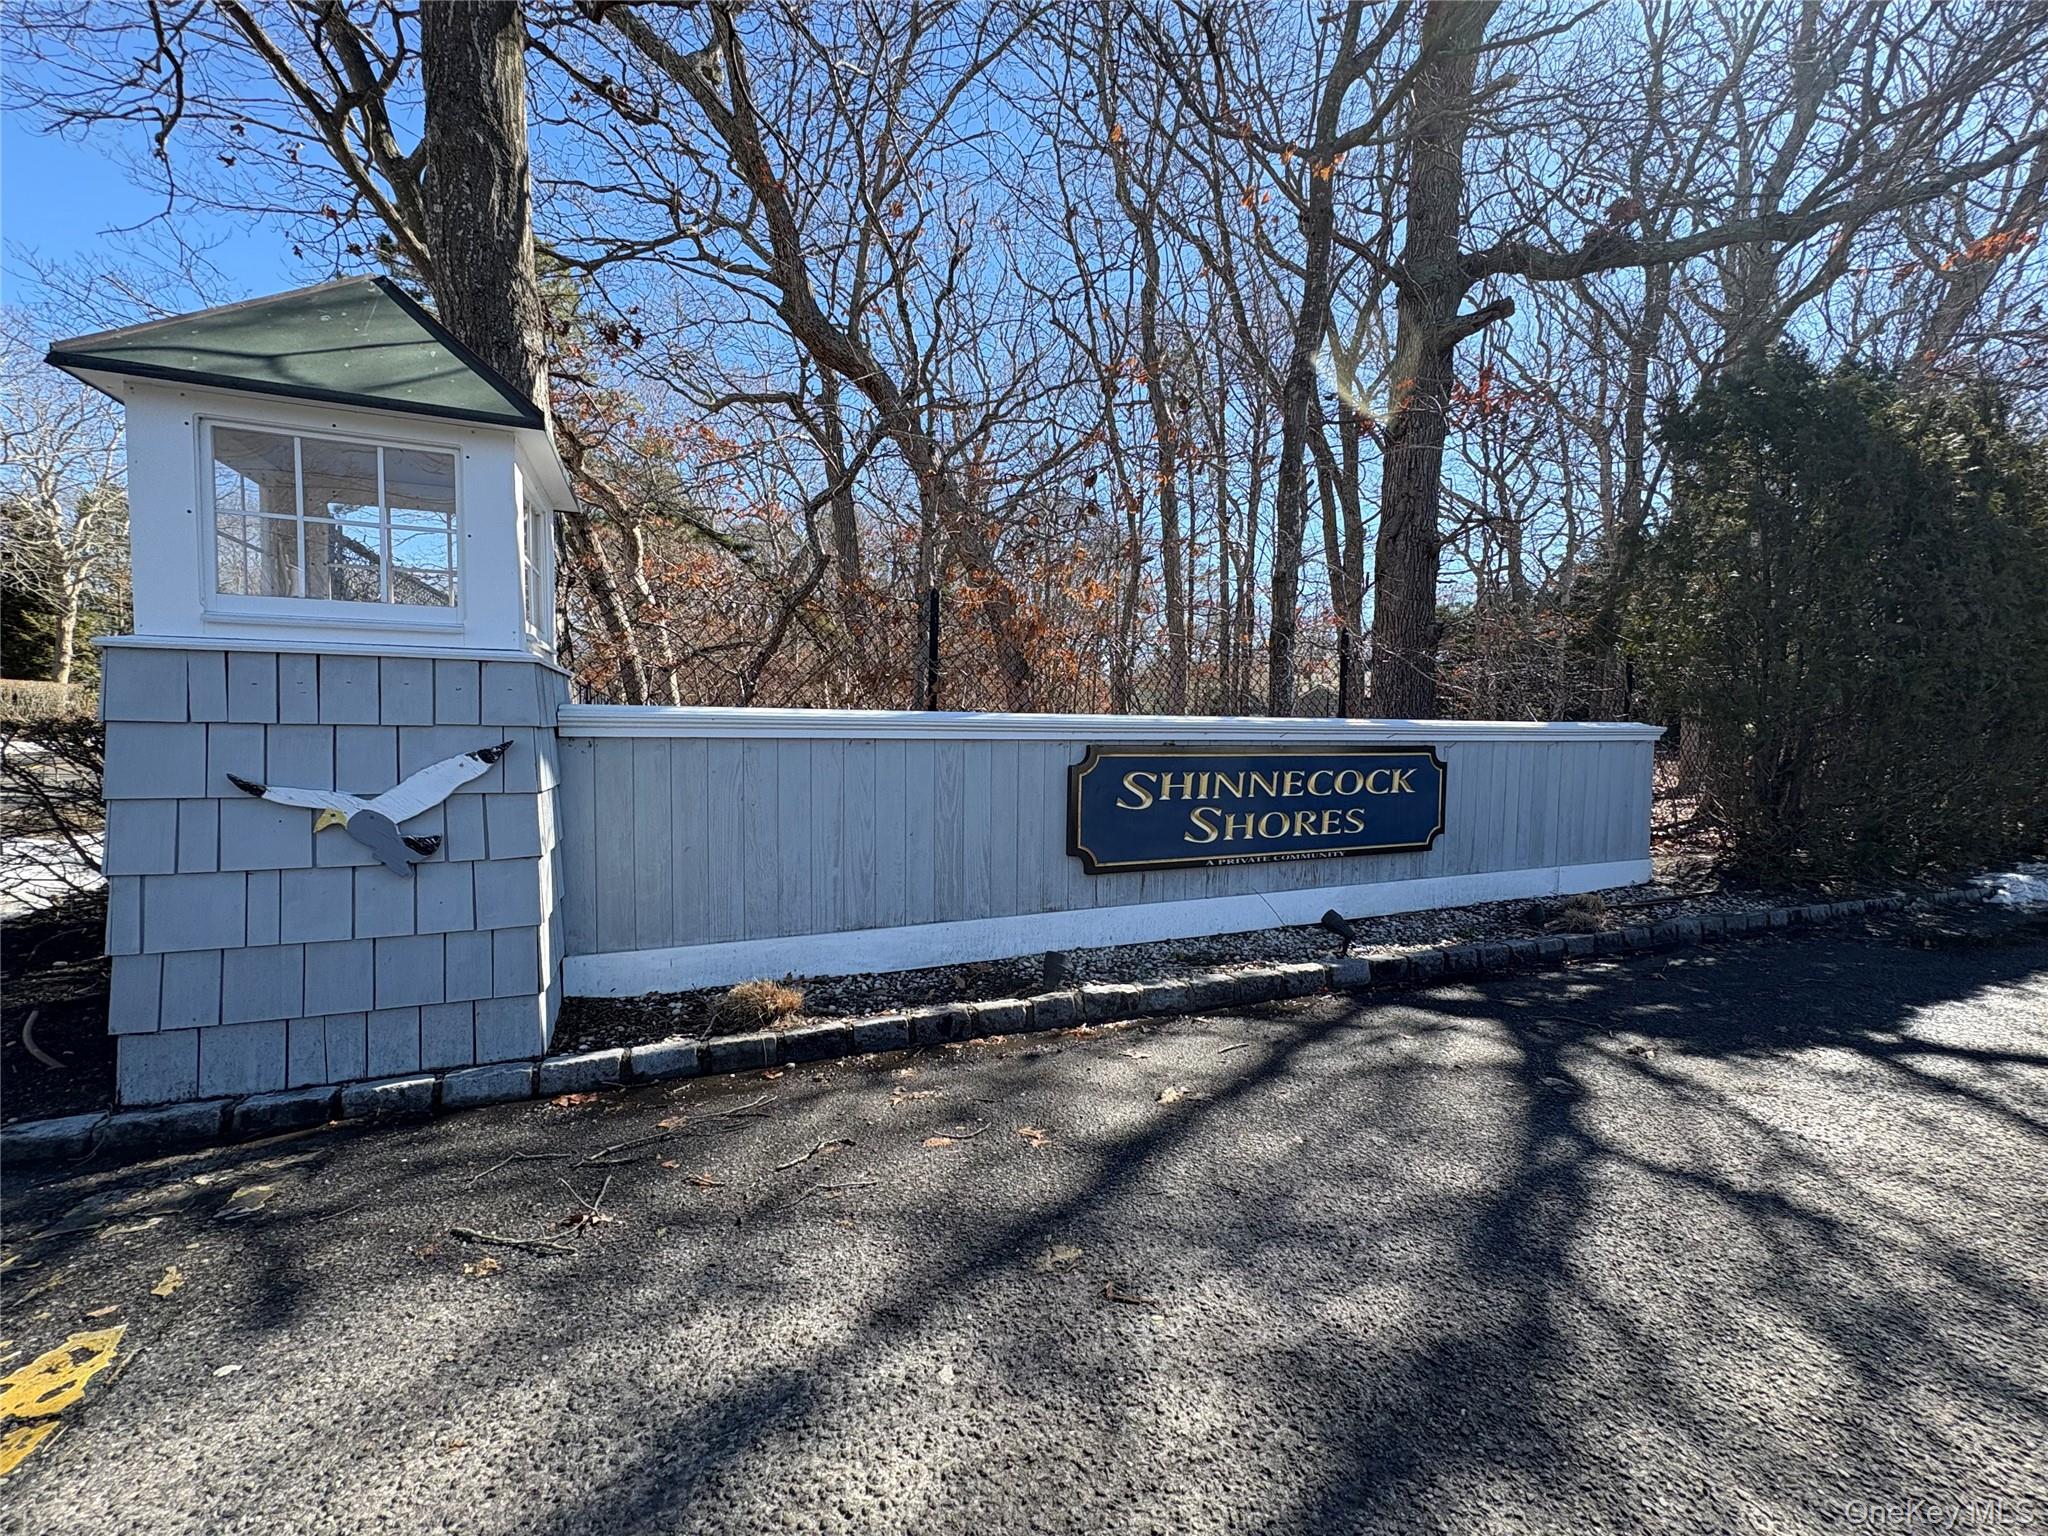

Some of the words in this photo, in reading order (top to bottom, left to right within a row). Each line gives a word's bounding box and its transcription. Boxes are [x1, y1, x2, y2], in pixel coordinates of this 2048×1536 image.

[1116, 768, 1417, 810] SHINNECOCK
[1184, 807, 1365, 843] SHORES
[1218, 856, 1270, 866] PRIVATE
[1273, 851, 1345, 861] COMMUNITY
